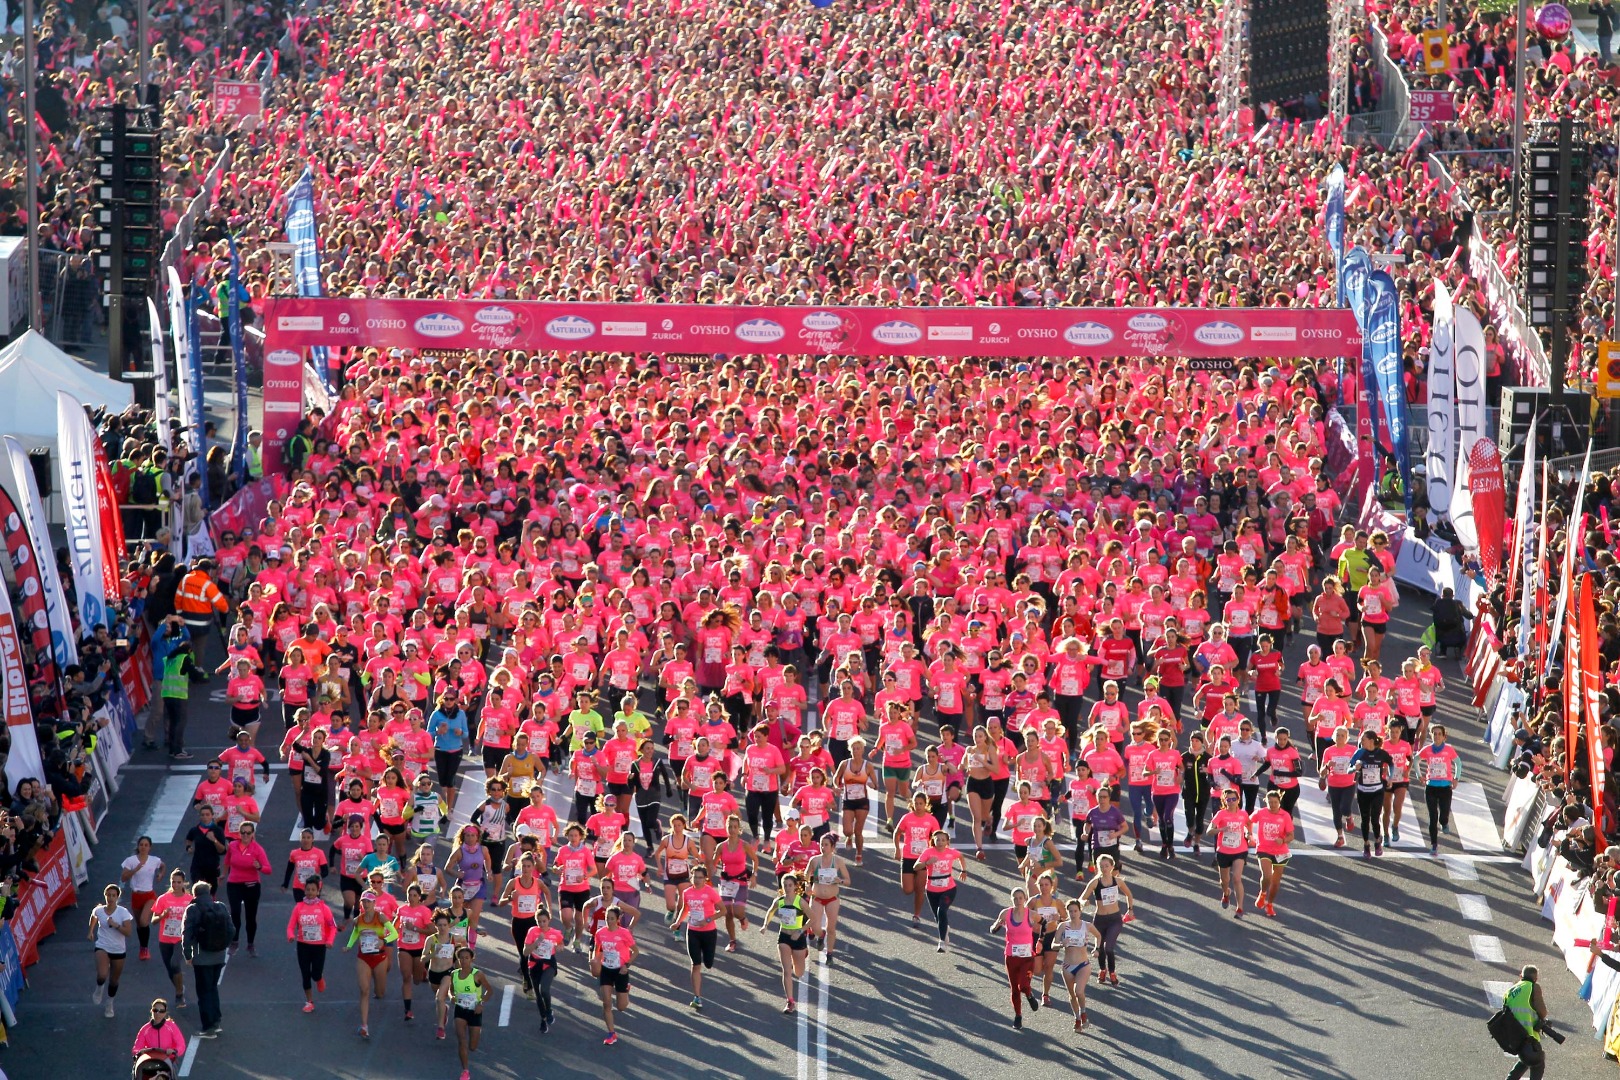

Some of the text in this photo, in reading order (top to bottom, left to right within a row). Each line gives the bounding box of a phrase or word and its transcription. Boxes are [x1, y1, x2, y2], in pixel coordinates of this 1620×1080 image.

[218, 86, 240, 96] SUB
[1412, 94, 1434, 104] SUB
[366, 319, 406, 329] OYSHO
[418, 322, 460, 332] ASTURIANA
[805, 318, 840, 326] ASTURIANA
[1130, 320, 1165, 328] ASTURIANA
[329, 326, 359, 334] ZURICH
[470, 322, 504, 333] Carrera
[550, 325, 592, 334] ASTURIANA
[690, 325, 730, 335] OYSHO
[739, 328, 781, 337] ASTURIANA
[652, 332, 682, 340] ZURICH
[798, 328, 832, 339] Carrera
[876, 329, 918, 338] ASTURIANA
[1018, 328, 1058, 338] OYSHO
[1068, 330, 1110, 340] ASTURIANA
[1123, 330, 1158, 340] Carrera
[1198, 330, 1240, 340] ASTURIANA
[1301, 328, 1342, 338] OYSHO
[980, 336, 1010, 344] ZURICH
[423, 350, 466, 358] OYSHO
[666, 355, 708, 364] OYSHO
[1190, 360, 1233, 370] OYSHO
[266, 380, 300, 389] OYSHO
